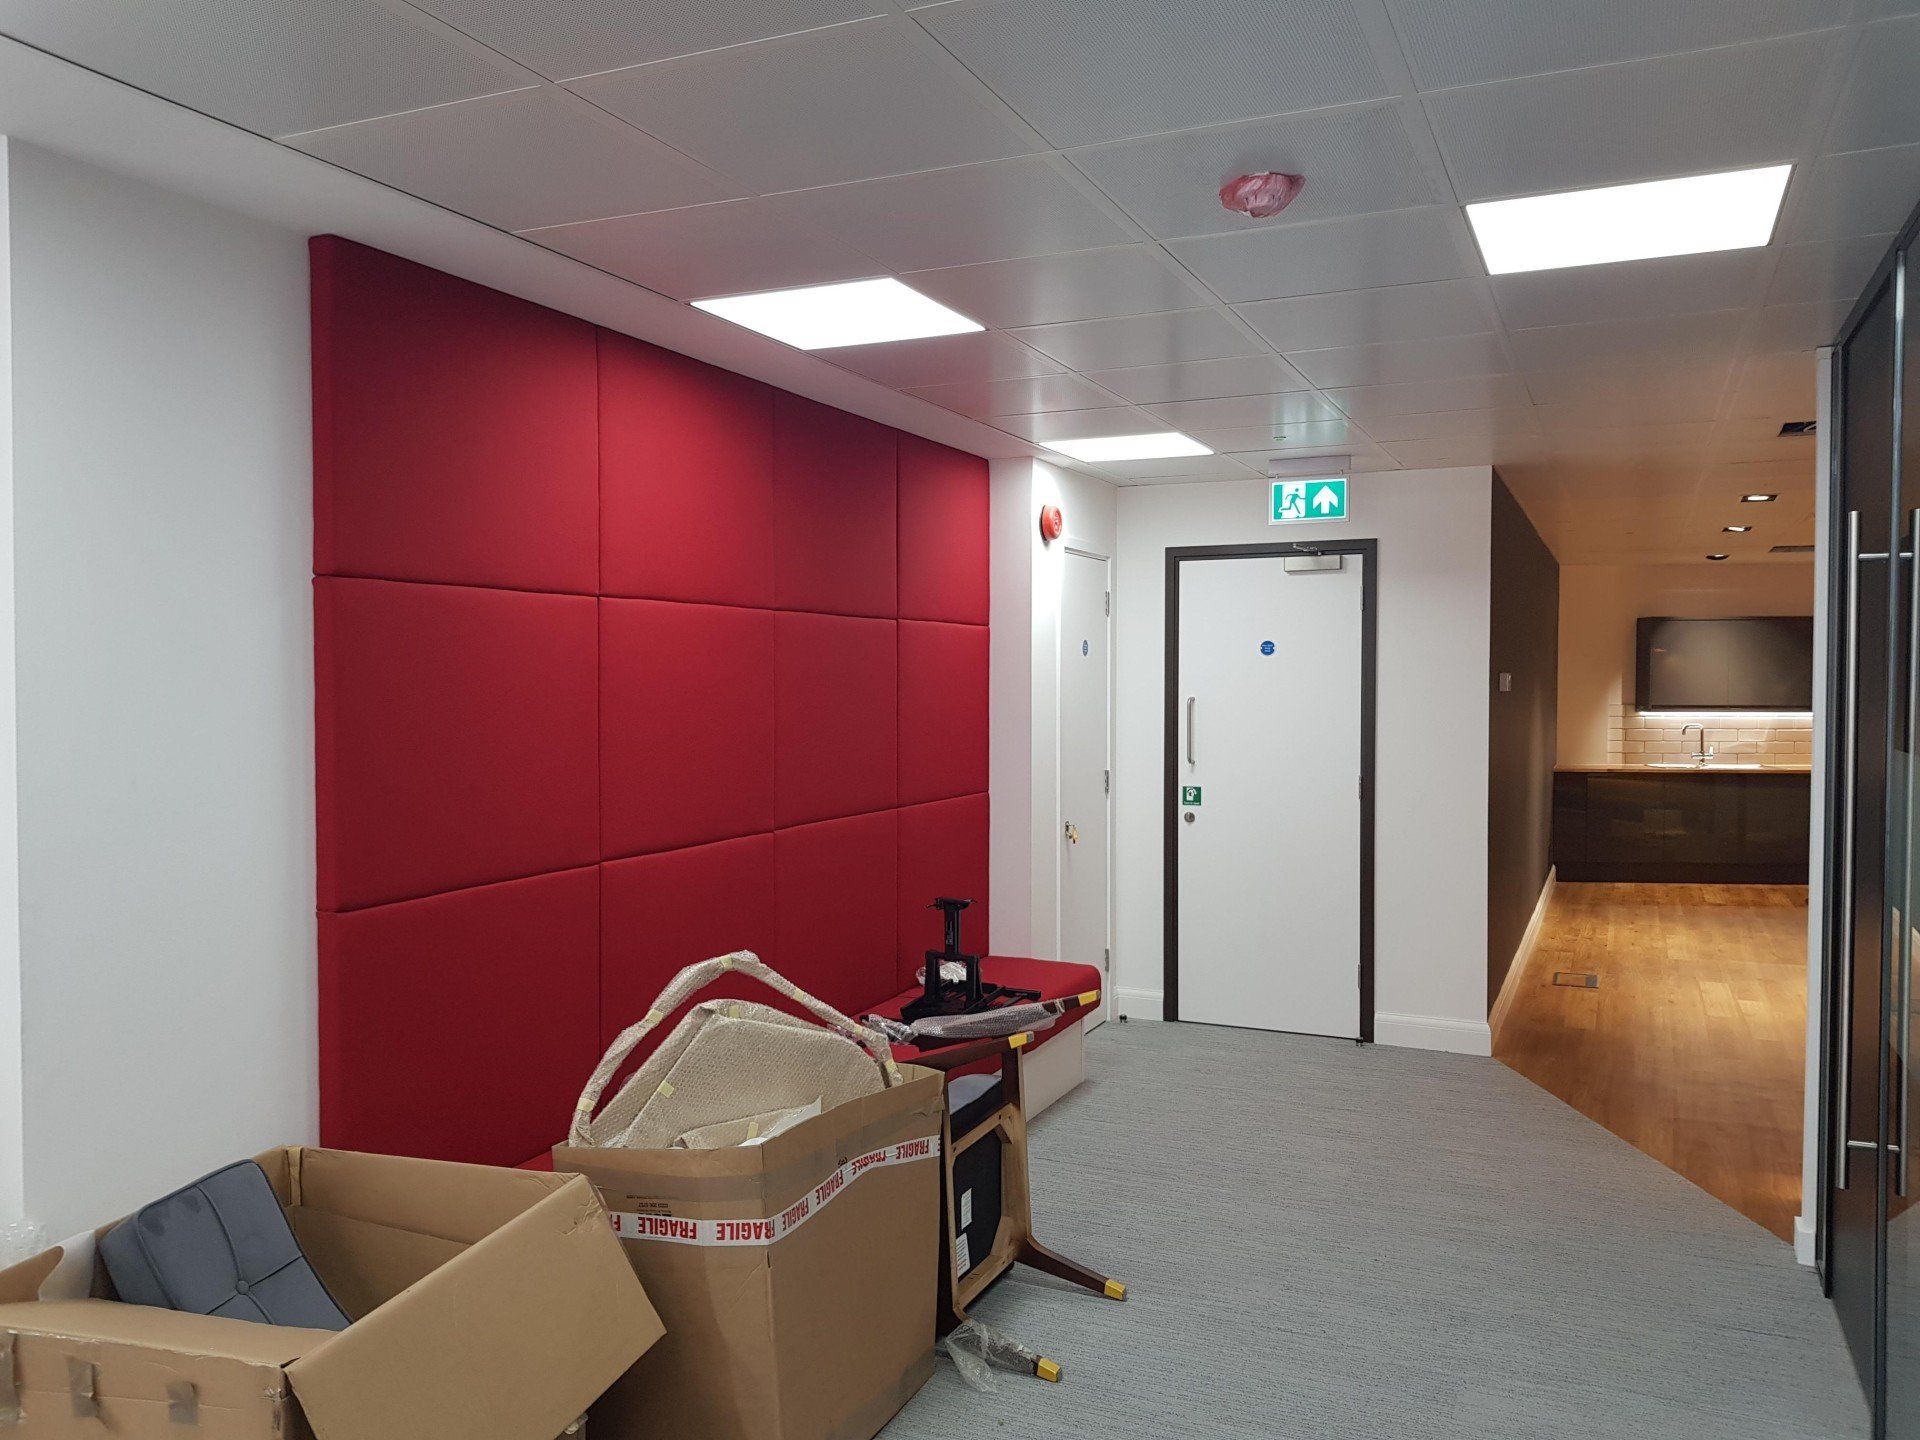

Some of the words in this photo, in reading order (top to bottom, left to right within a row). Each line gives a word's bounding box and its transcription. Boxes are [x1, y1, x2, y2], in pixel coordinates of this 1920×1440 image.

[895, 1139, 930, 1160] FRAGILE
[815, 1169, 844, 1206] FRAGILE
[782, 1197, 809, 1231] FRAGILE
[637, 1216, 697, 1240] FRAGILE
[716, 1219, 775, 1241] FRAGILE
